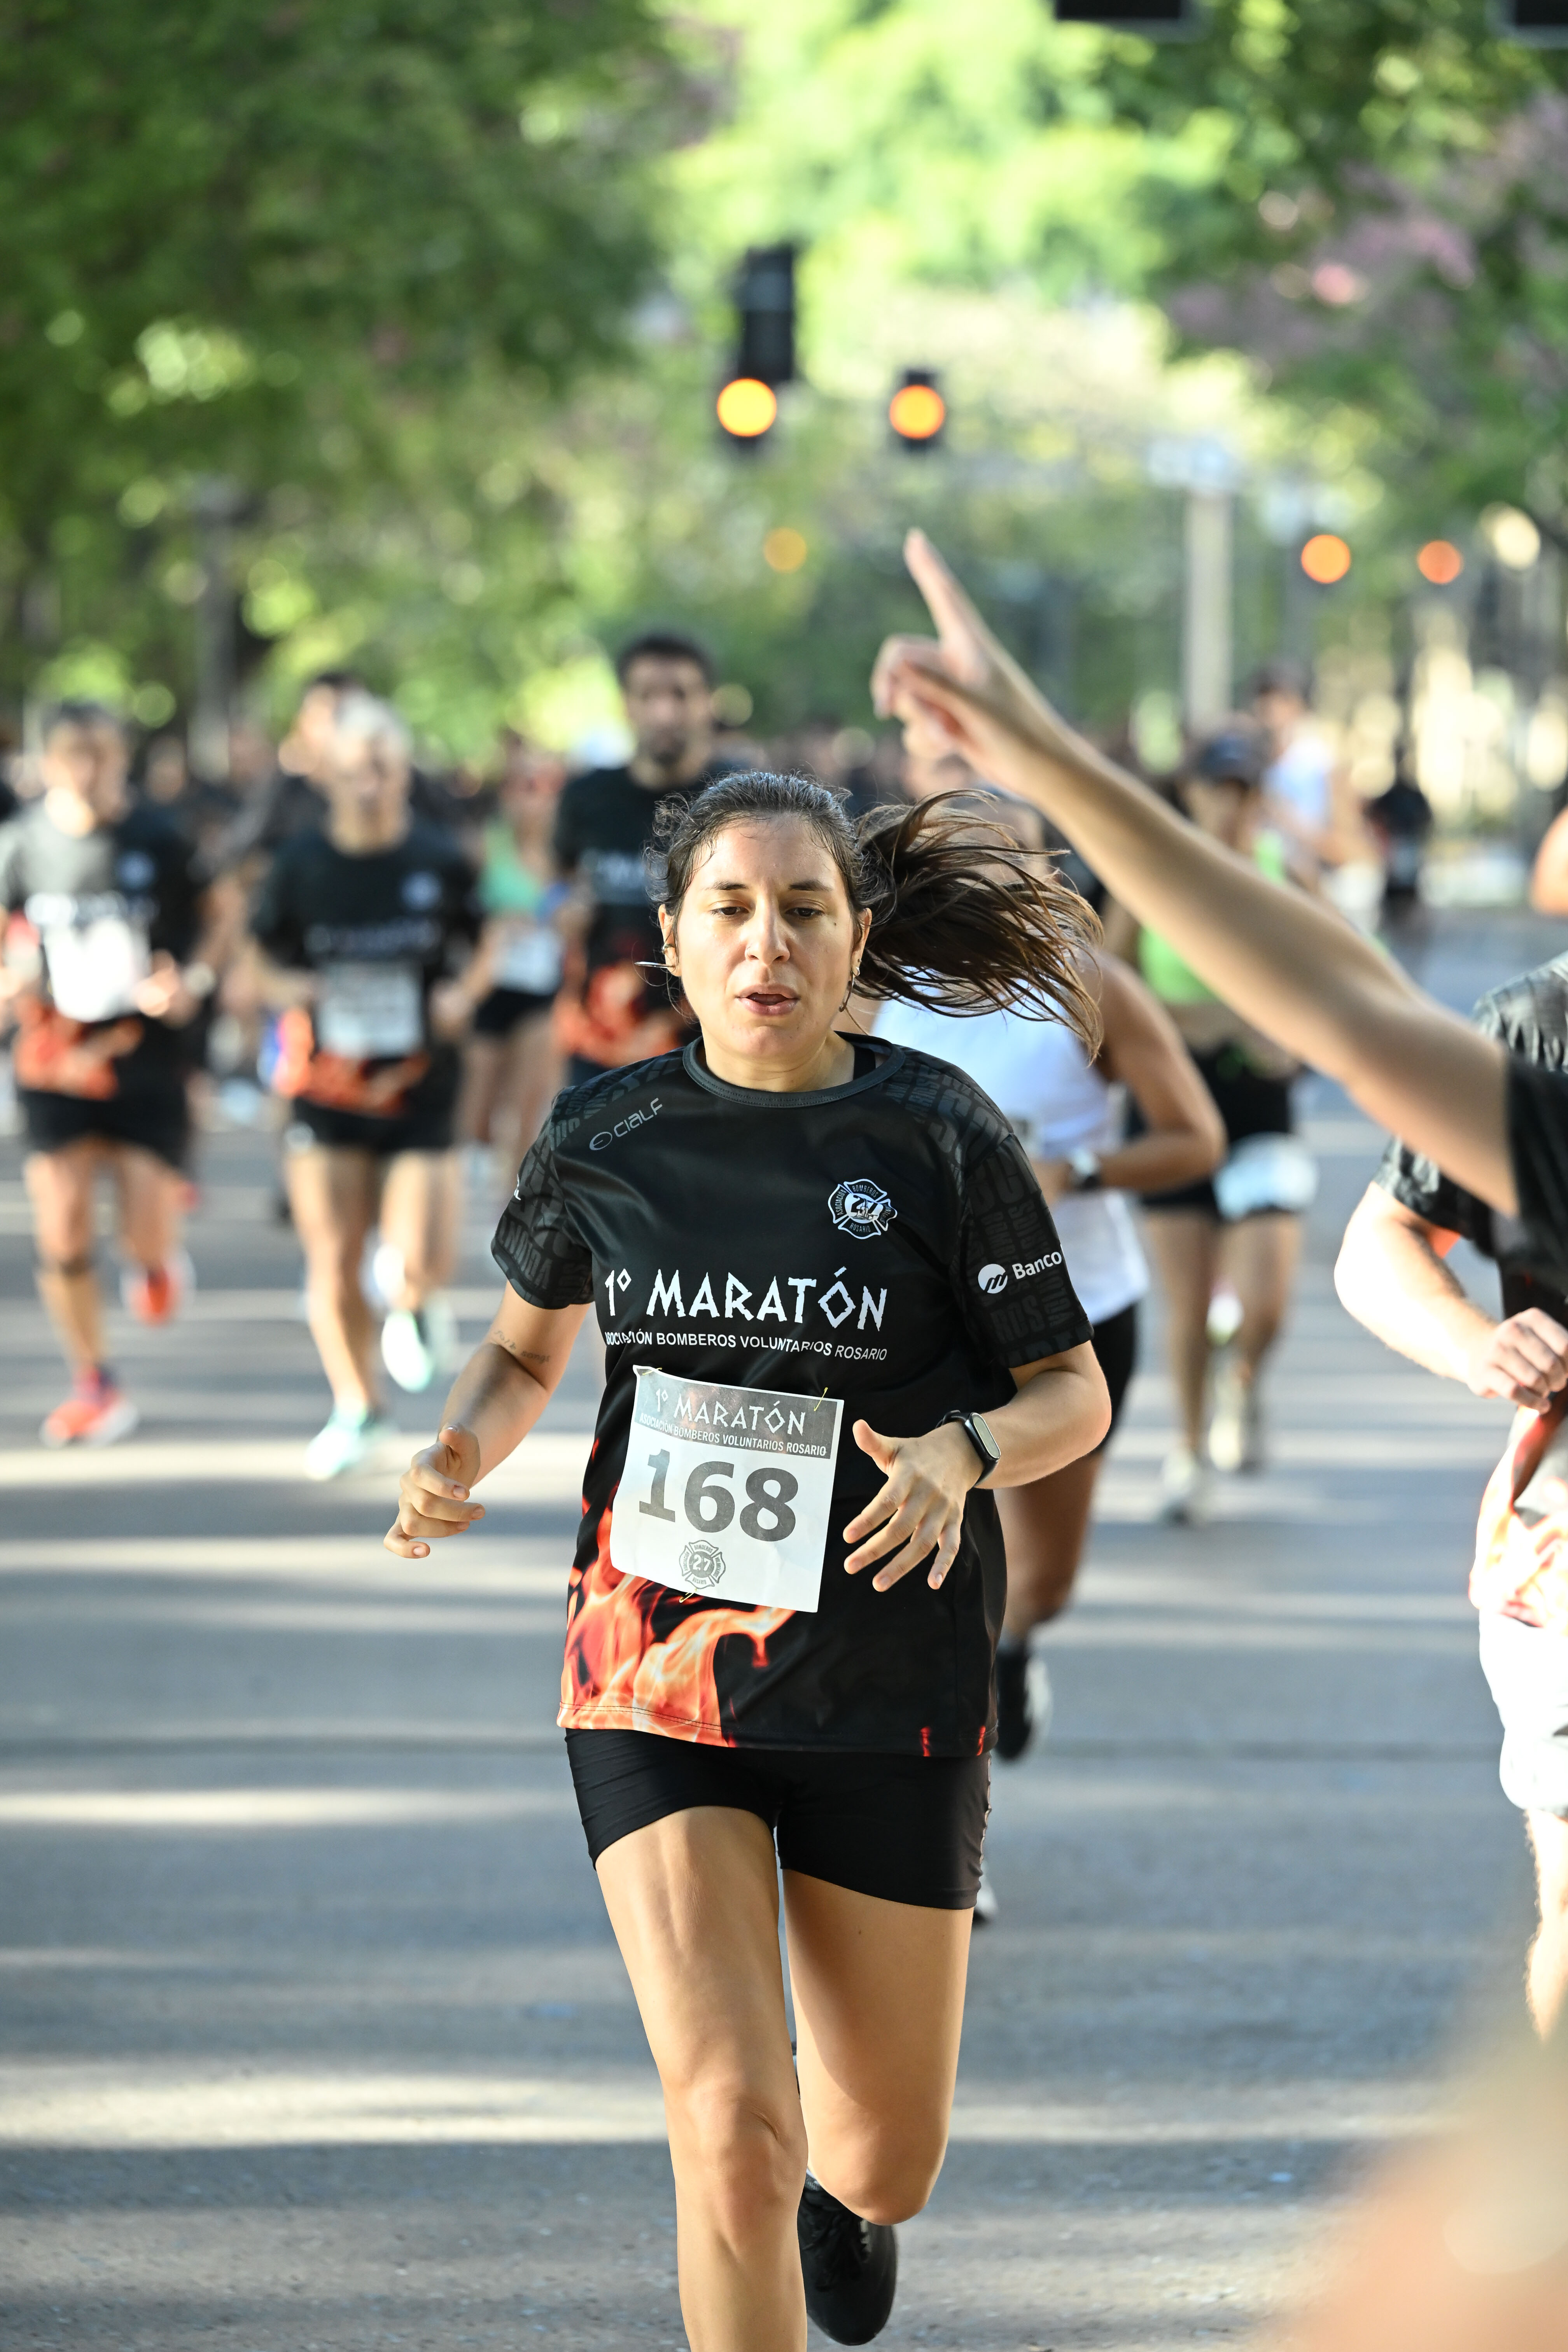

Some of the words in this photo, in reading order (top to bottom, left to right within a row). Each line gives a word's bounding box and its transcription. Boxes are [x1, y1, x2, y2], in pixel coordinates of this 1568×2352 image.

[852, 1185, 878, 1198] BOMBEROS
[849, 1223, 871, 1232] ROSARIO
[1012, 1251, 1062, 1279] Banco
[646, 1266, 888, 1332] MARATÓN
[656, 1332, 736, 1348] BOMBEROS
[740, 1335, 833, 1356] VOLUNTARIOS
[835, 1345, 887, 1360] ROSARIO
[673, 1394, 805, 1436] MARATÓN
[639, 1413, 672, 1434] ASOCIACIÓN
[674, 1426, 720, 1444] BOMBEROS
[723, 1434, 784, 1451] VOLUNTARIOS
[786, 1442, 826, 1456] ROSARIO
[639, 1448, 799, 1542] 168
[693, 1554, 711, 1571] 27
